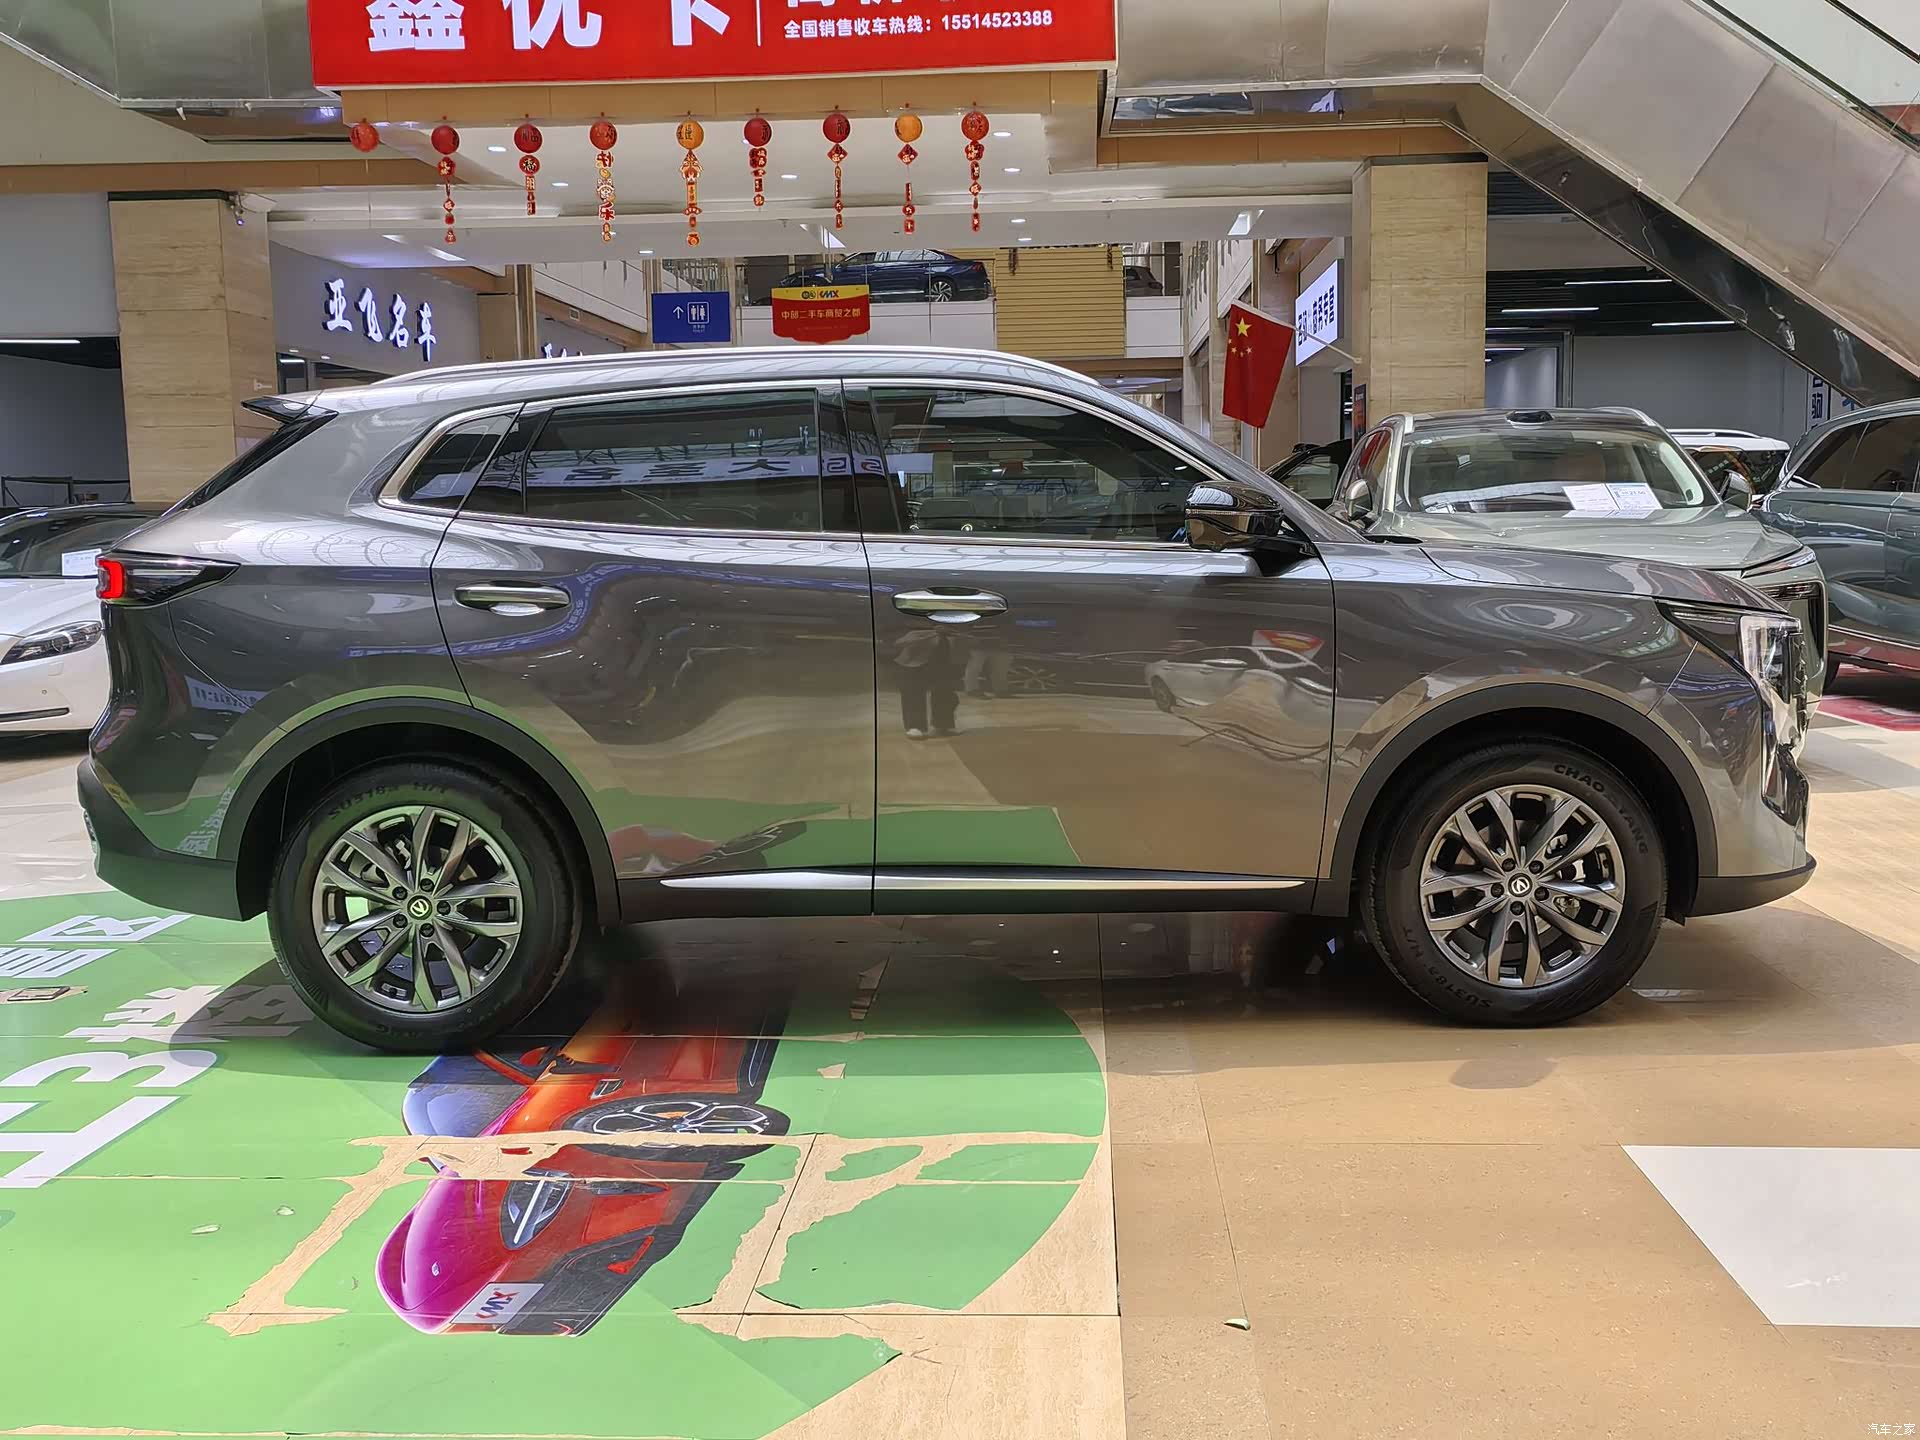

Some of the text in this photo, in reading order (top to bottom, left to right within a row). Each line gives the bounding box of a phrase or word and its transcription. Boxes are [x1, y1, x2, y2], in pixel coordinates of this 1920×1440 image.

[941, 10, 1053, 30] 15514523388
[325, 278, 437, 362] 亚飞名车
[1553, 764, 1605, 793] CHAO
